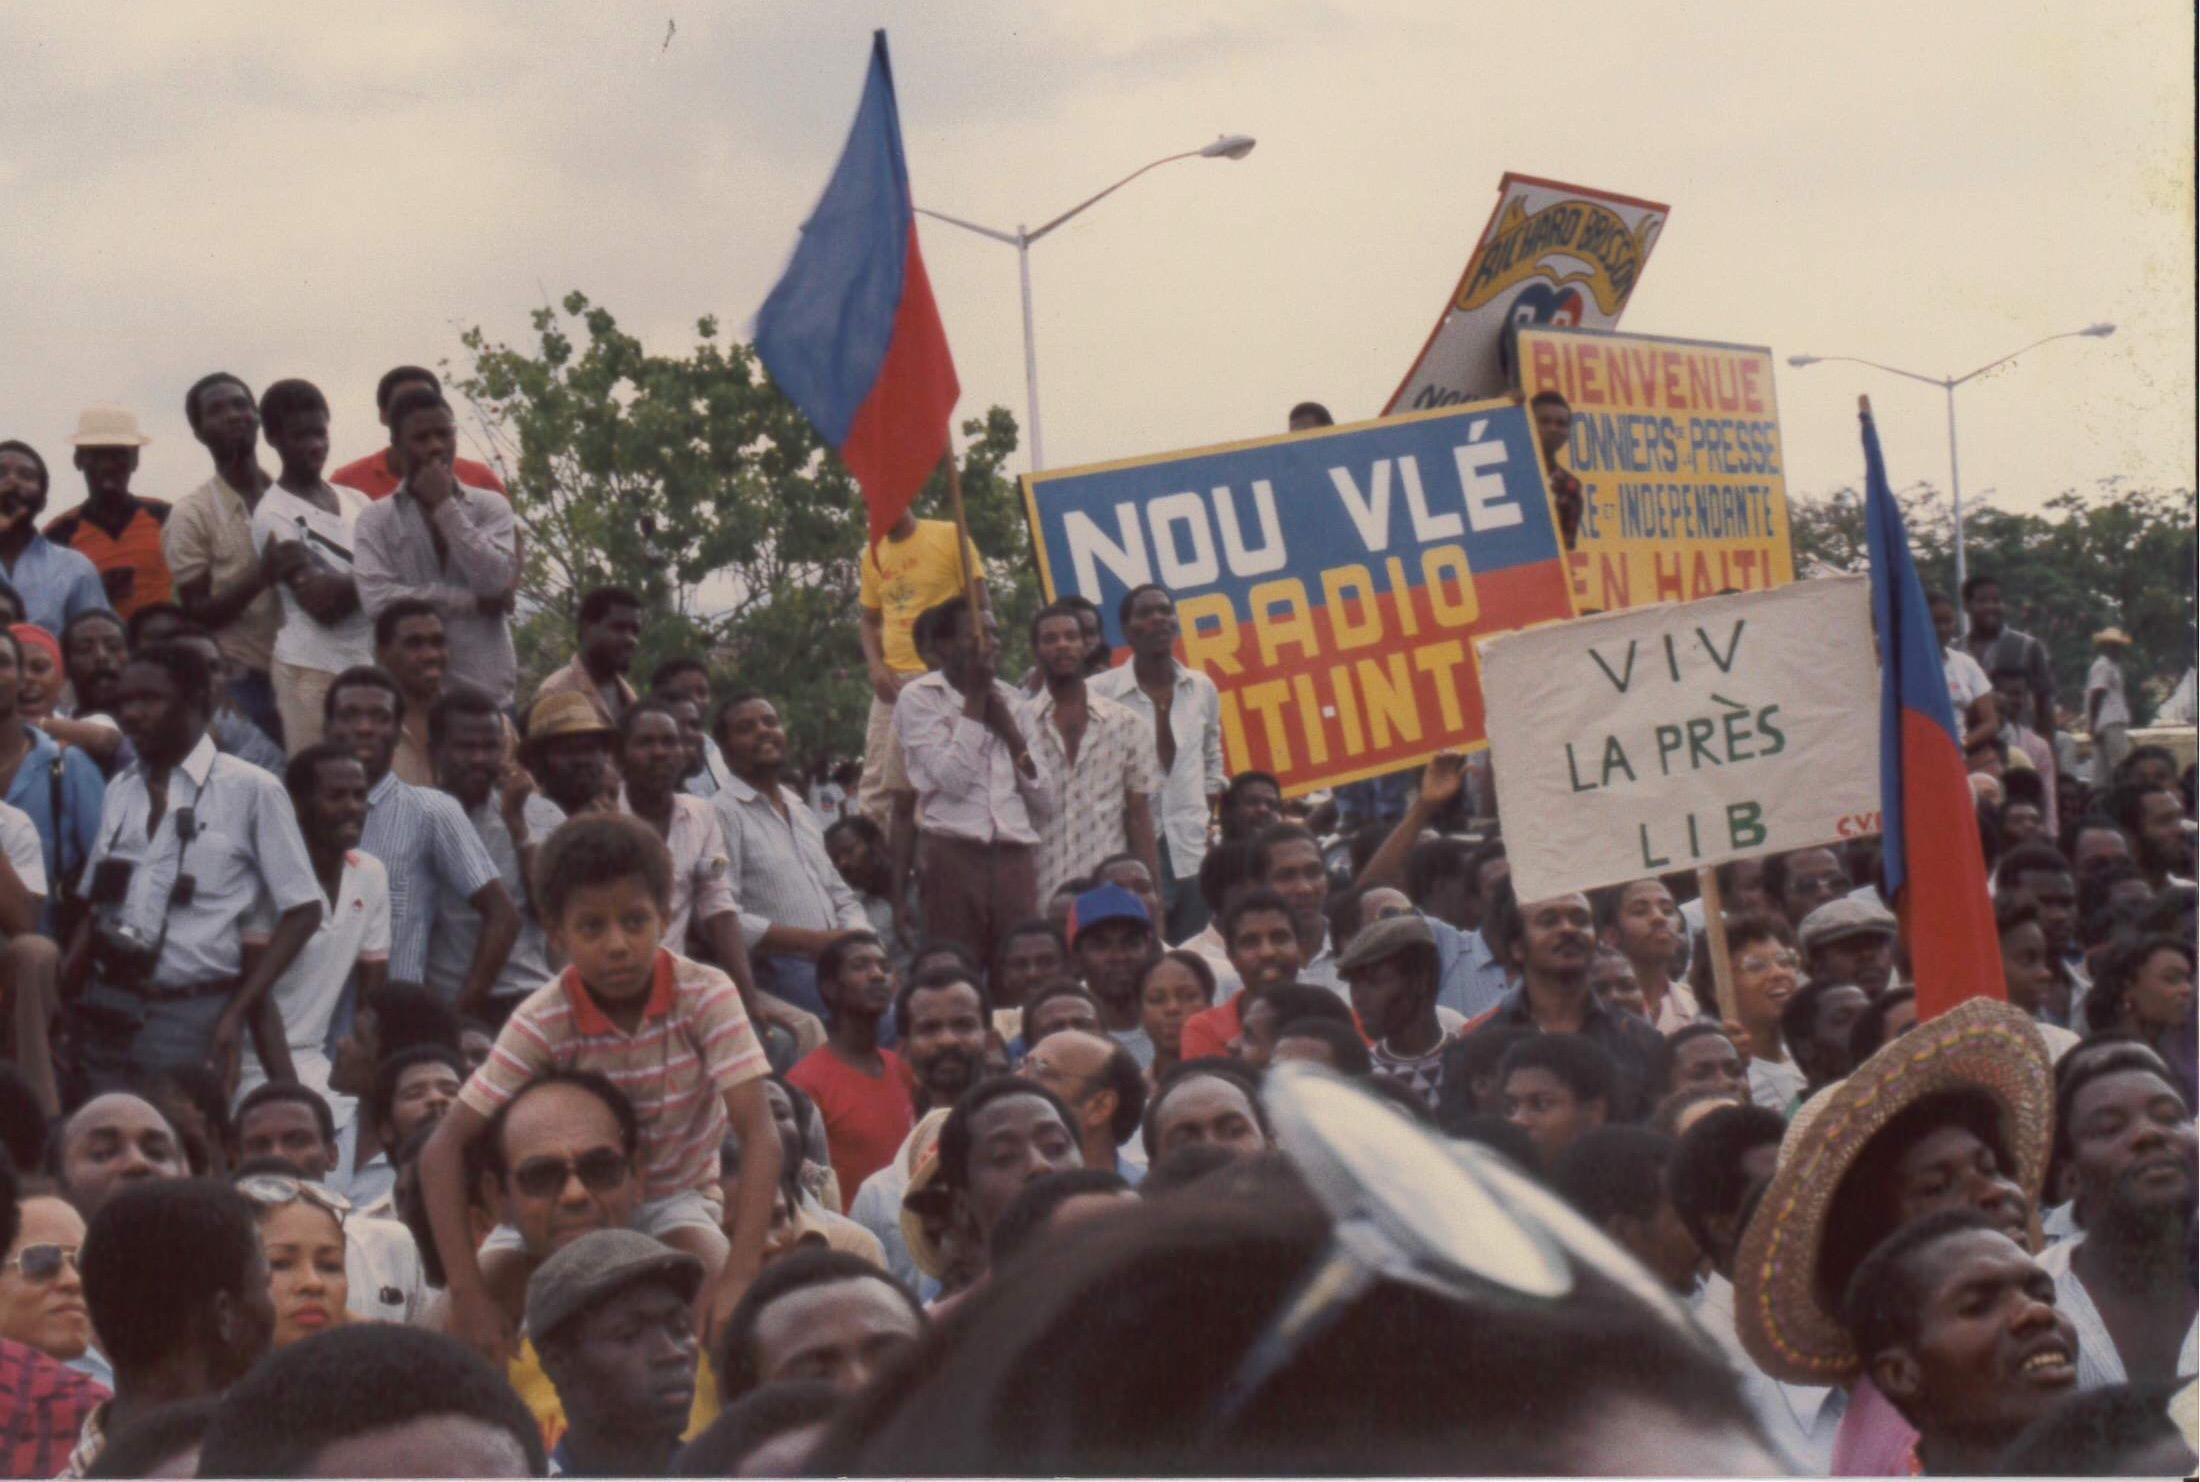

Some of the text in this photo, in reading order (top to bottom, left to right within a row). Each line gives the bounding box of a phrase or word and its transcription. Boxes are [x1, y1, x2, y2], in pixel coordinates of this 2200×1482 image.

[1532, 340, 1764, 413] BIENVENUE
[1690, 417, 1779, 474] PRESSE
[1062, 418, 1524, 605] NOU VLÉ
[1619, 482, 1776, 538] INDEPENDANTE
[1176, 544, 1480, 675] RADIO
[1567, 548, 1772, 611] EN HAITI
[1588, 619, 1746, 693] VIV
[1565, 693, 1786, 792] LA PRÈS
[1639, 801, 1767, 868] LIB
